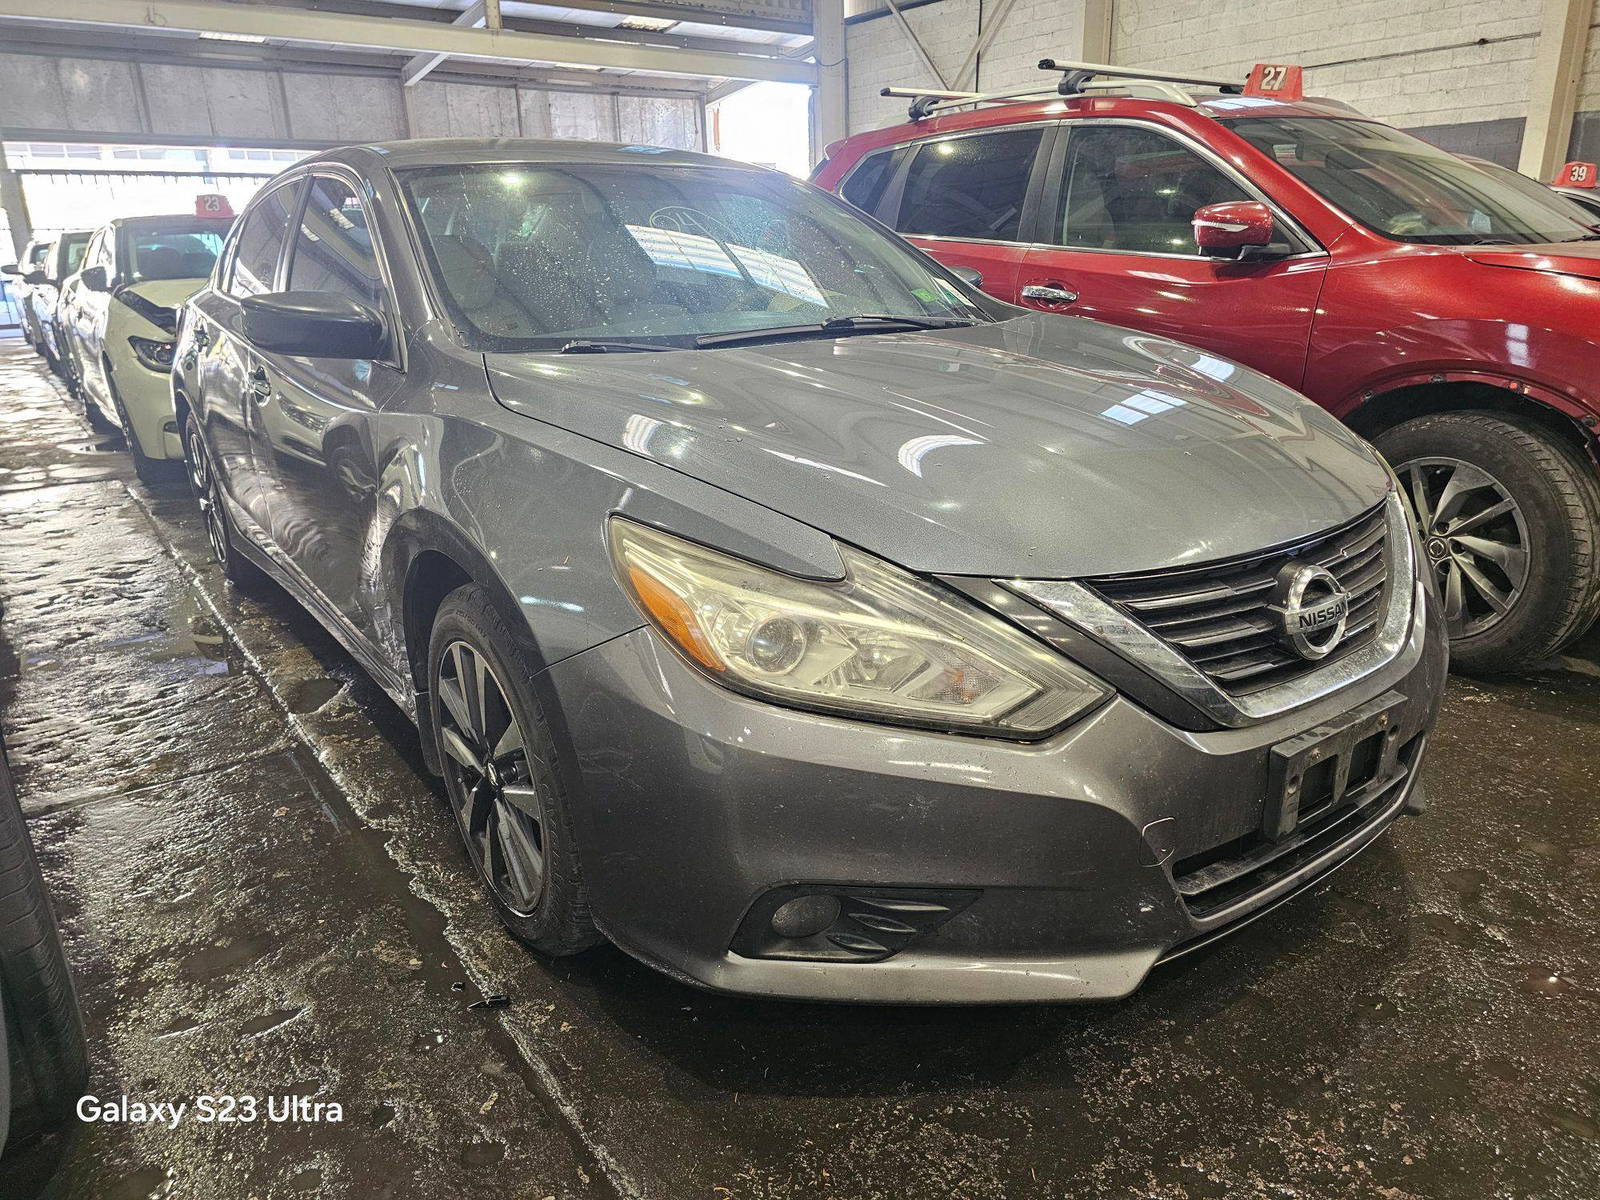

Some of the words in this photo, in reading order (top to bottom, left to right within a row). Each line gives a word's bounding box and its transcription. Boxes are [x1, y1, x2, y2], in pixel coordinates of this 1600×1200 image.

[1260, 66, 1288, 91] 27
[1570, 165, 1588, 182] 39
[204, 195, 220, 211] 23
[1299, 601, 1346, 628] NISSAN
